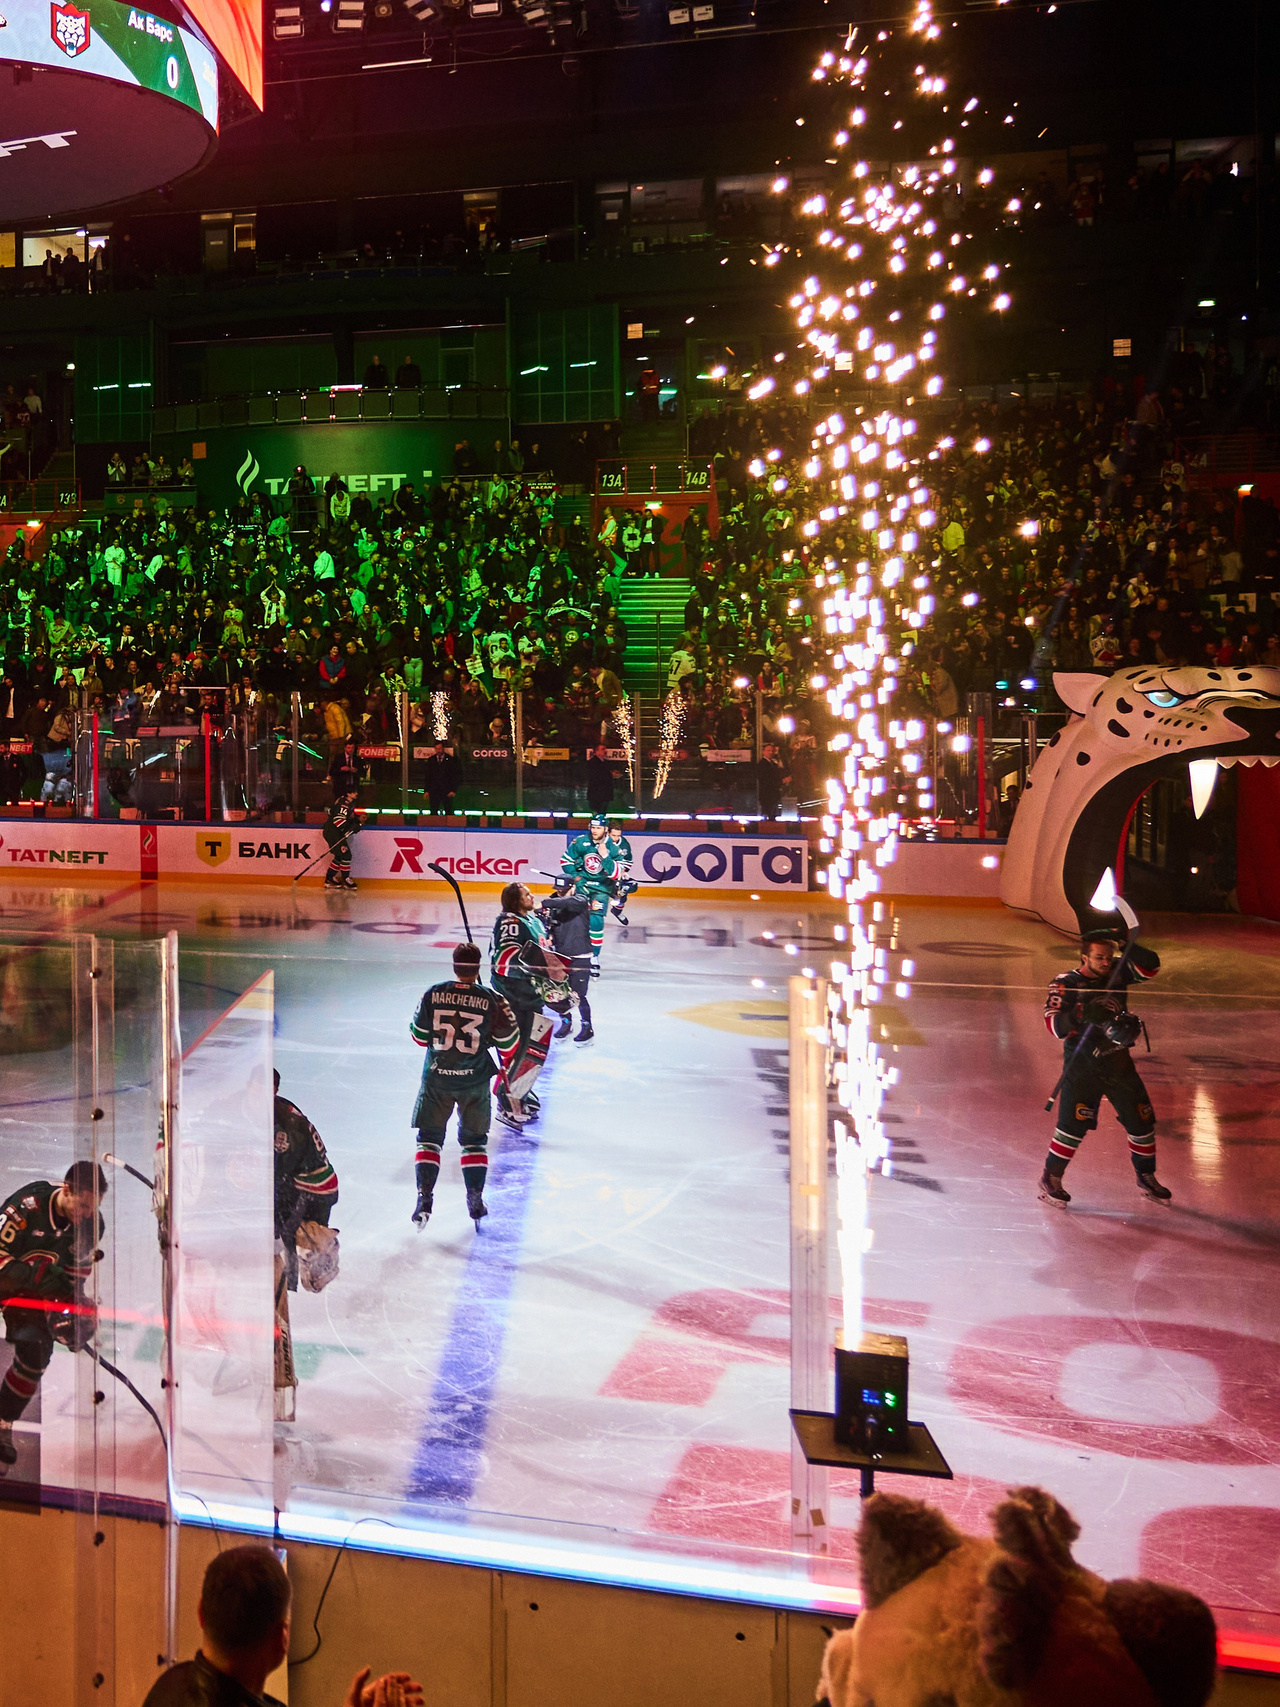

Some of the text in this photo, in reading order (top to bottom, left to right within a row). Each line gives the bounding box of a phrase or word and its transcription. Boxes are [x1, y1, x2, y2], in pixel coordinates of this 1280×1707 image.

[127, 7, 173, 43] Ак Барс
[165, 56, 180, 90] 0
[601, 473, 623, 488] 13A
[10, 743, 33, 753] NBET
[358, 747, 398, 758] FONBET
[472, 749, 509, 758] согаз
[7, 848, 109, 864] TATNEFT
[238, 841, 312, 860] БАНК
[433, 850, 529, 875] rieker
[499, 924, 521, 938] 20
[431, 991, 490, 1012] MARCHENKO
[432, 1008, 485, 1056] 53
[436, 1067, 476, 1077] TATNEFT
